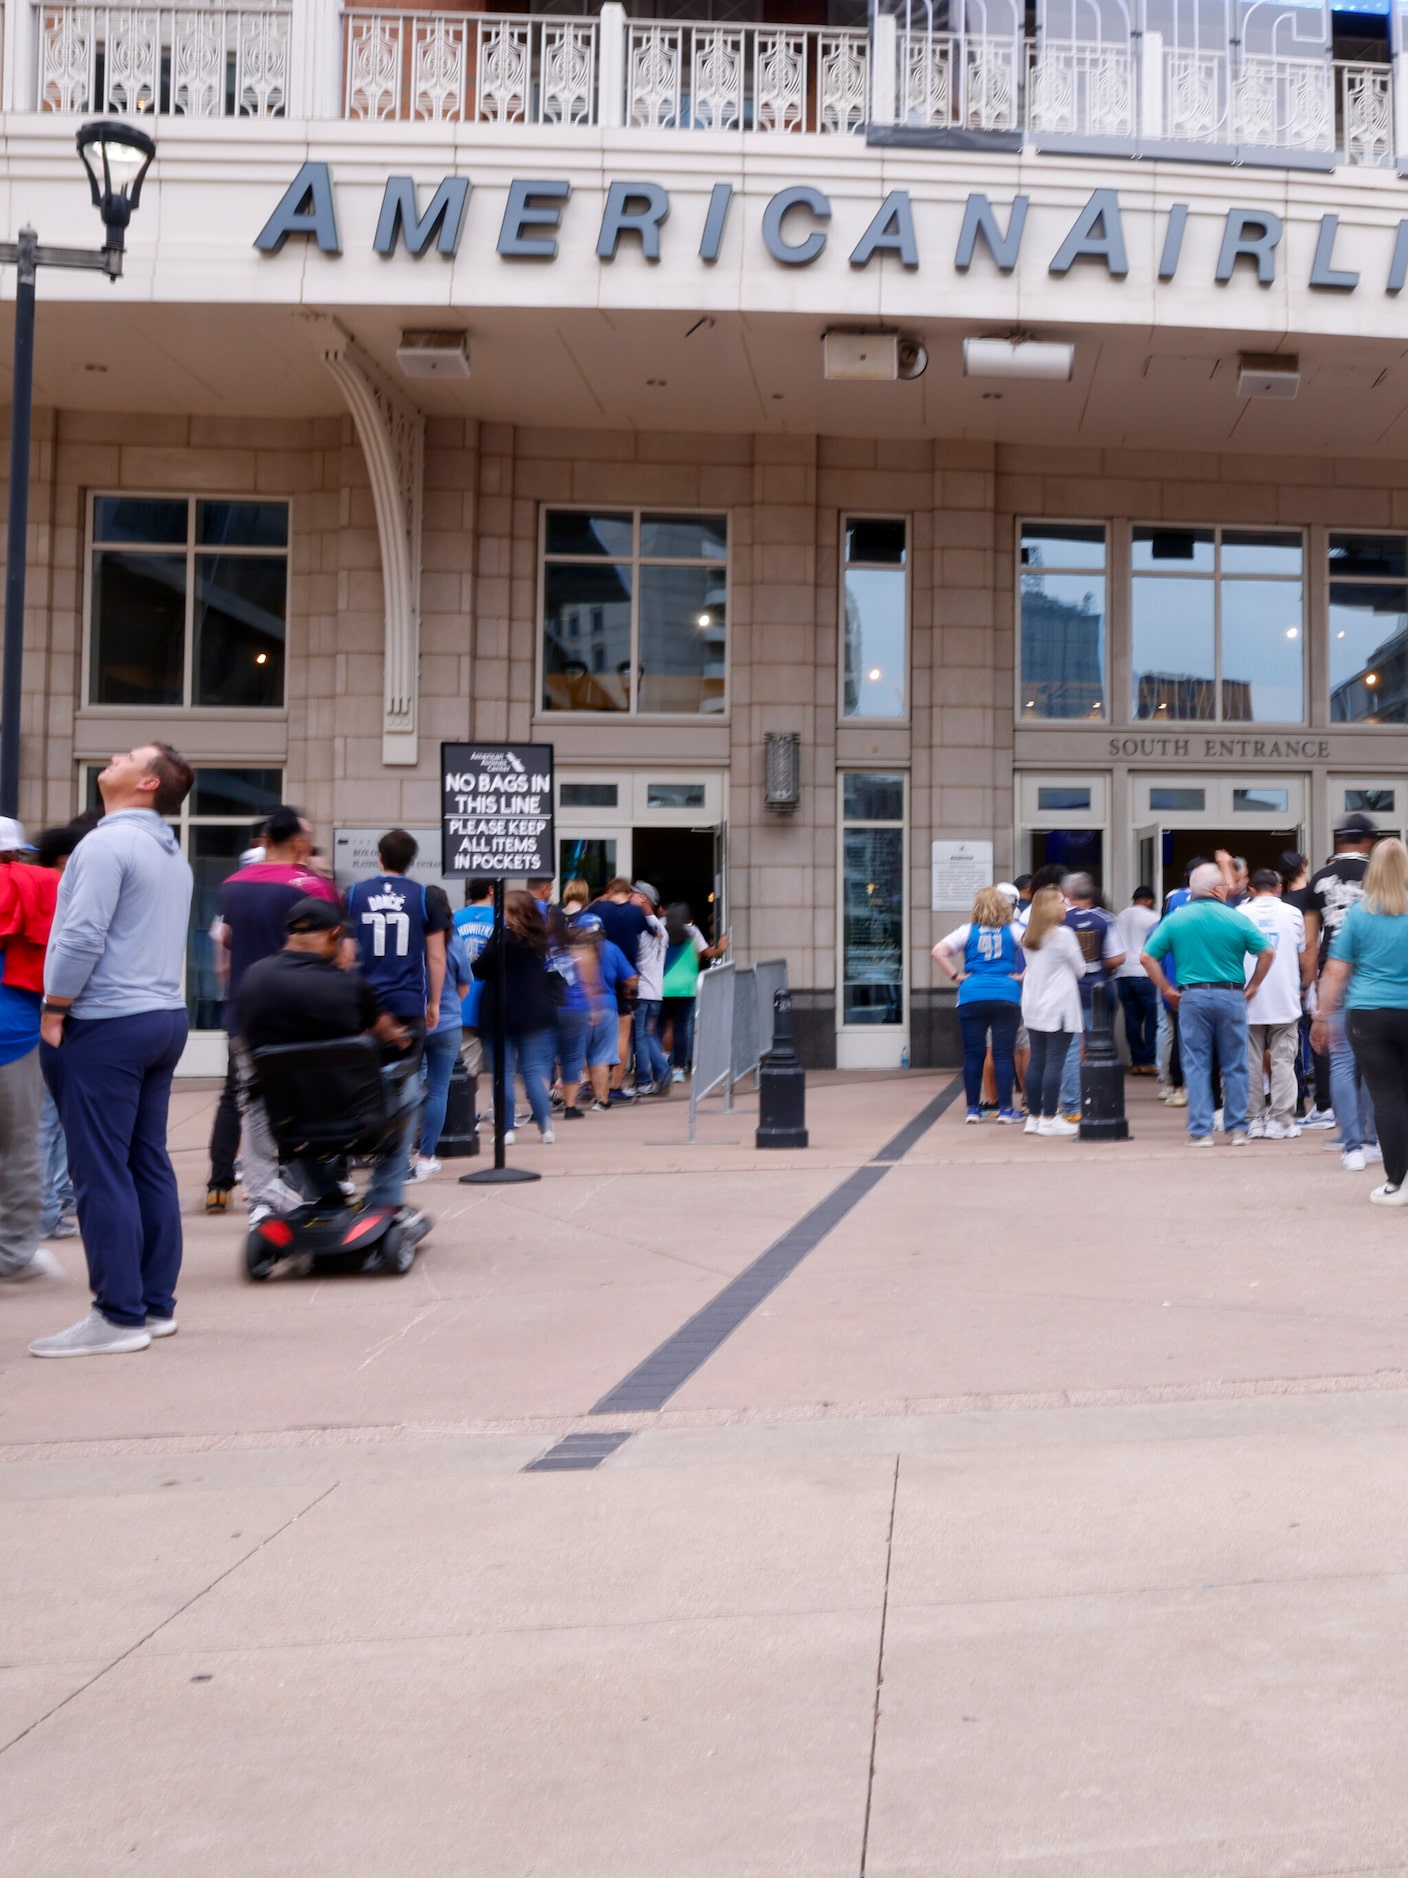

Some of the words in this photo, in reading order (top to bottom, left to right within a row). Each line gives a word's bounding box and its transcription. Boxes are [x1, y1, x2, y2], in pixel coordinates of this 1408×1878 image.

[252, 162, 1030, 272] AMERICAN
[1108, 738, 1190, 757] SOUTH
[1203, 739, 1331, 758] ENTRANCE
[445, 772, 476, 793] NO
[478, 773, 529, 793] BAGS
[531, 773, 551, 794] IN
[455, 794, 498, 814] THIS
[500, 794, 542, 815] LINE
[449, 819, 506, 835] PLEASE
[508, 820, 547, 836] KEEP
[459, 836, 491, 852] ALL
[492, 836, 538, 853] ITEMS
[454, 853, 471, 870] IN
[472, 853, 542, 870] POCKETS
[361, 911, 411, 957] 77
[977, 932, 1003, 961] 41
